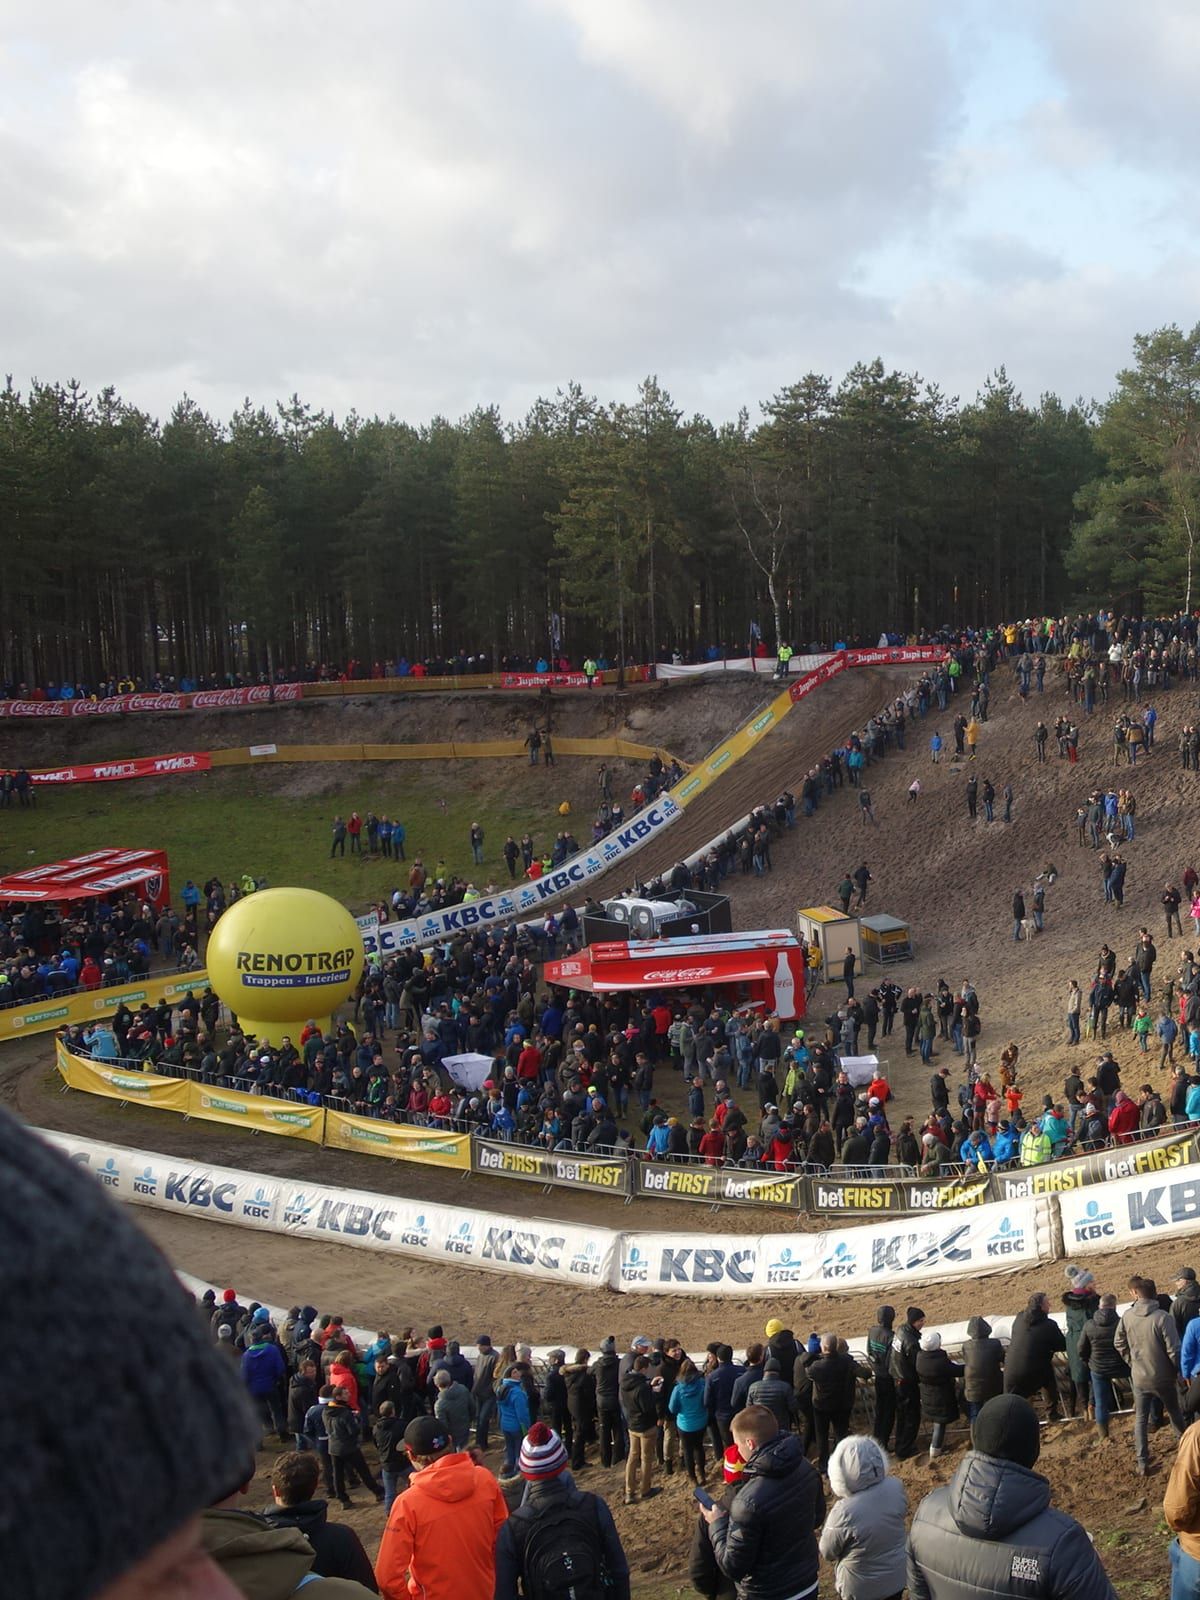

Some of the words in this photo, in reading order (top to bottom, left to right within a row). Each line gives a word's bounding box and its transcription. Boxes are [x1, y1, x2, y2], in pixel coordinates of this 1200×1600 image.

[856, 653, 887, 663] Jupiler
[901, 650, 932, 660] Jupier
[517, 676, 551, 687] Jupiler
[94, 765, 123, 778] TVH
[155, 758, 183, 771] TVH
[665, 805, 680, 818] KBC
[617, 809, 664, 850] KBC
[605, 848, 621, 862] KBC
[587, 863, 602, 875] KBC
[536, 864, 585, 899] KBC
[500, 905, 515, 915] KBC
[521, 897, 537, 909] KBC
[442, 901, 496, 931] KBC
[422, 927, 441, 938] KBC
[363, 931, 395, 955] BC
[400, 936, 417, 947] KBC
[237, 948, 354, 972] RENOTRAP
[245, 975, 293, 986] Trappen
[305, 971, 348, 985] Interieur
[480, 1147, 544, 1175] betFIRST
[1104, 1140, 1192, 1181] betFIRST
[557, 1160, 622, 1187] betFIRST
[645, 1169, 713, 1195] betFIRST
[133, 1182, 157, 1197] KBC
[725, 1178, 795, 1204] betFIRST
[1005, 1165, 1086, 1200] betFIRST
[165, 1171, 236, 1213] KBC
[818, 1187, 894, 1208] betFIRST
[243, 1203, 270, 1220] KBC
[317, 1199, 397, 1241] KBC
[401, 1232, 429, 1248] KBC
[1075, 1222, 1115, 1242] KBC
[445, 1239, 473, 1255] KBC
[987, 1239, 1024, 1257] KBC
[658, 1248, 755, 1284] KBC
[1013, 1555, 1038, 1567] SUPER
